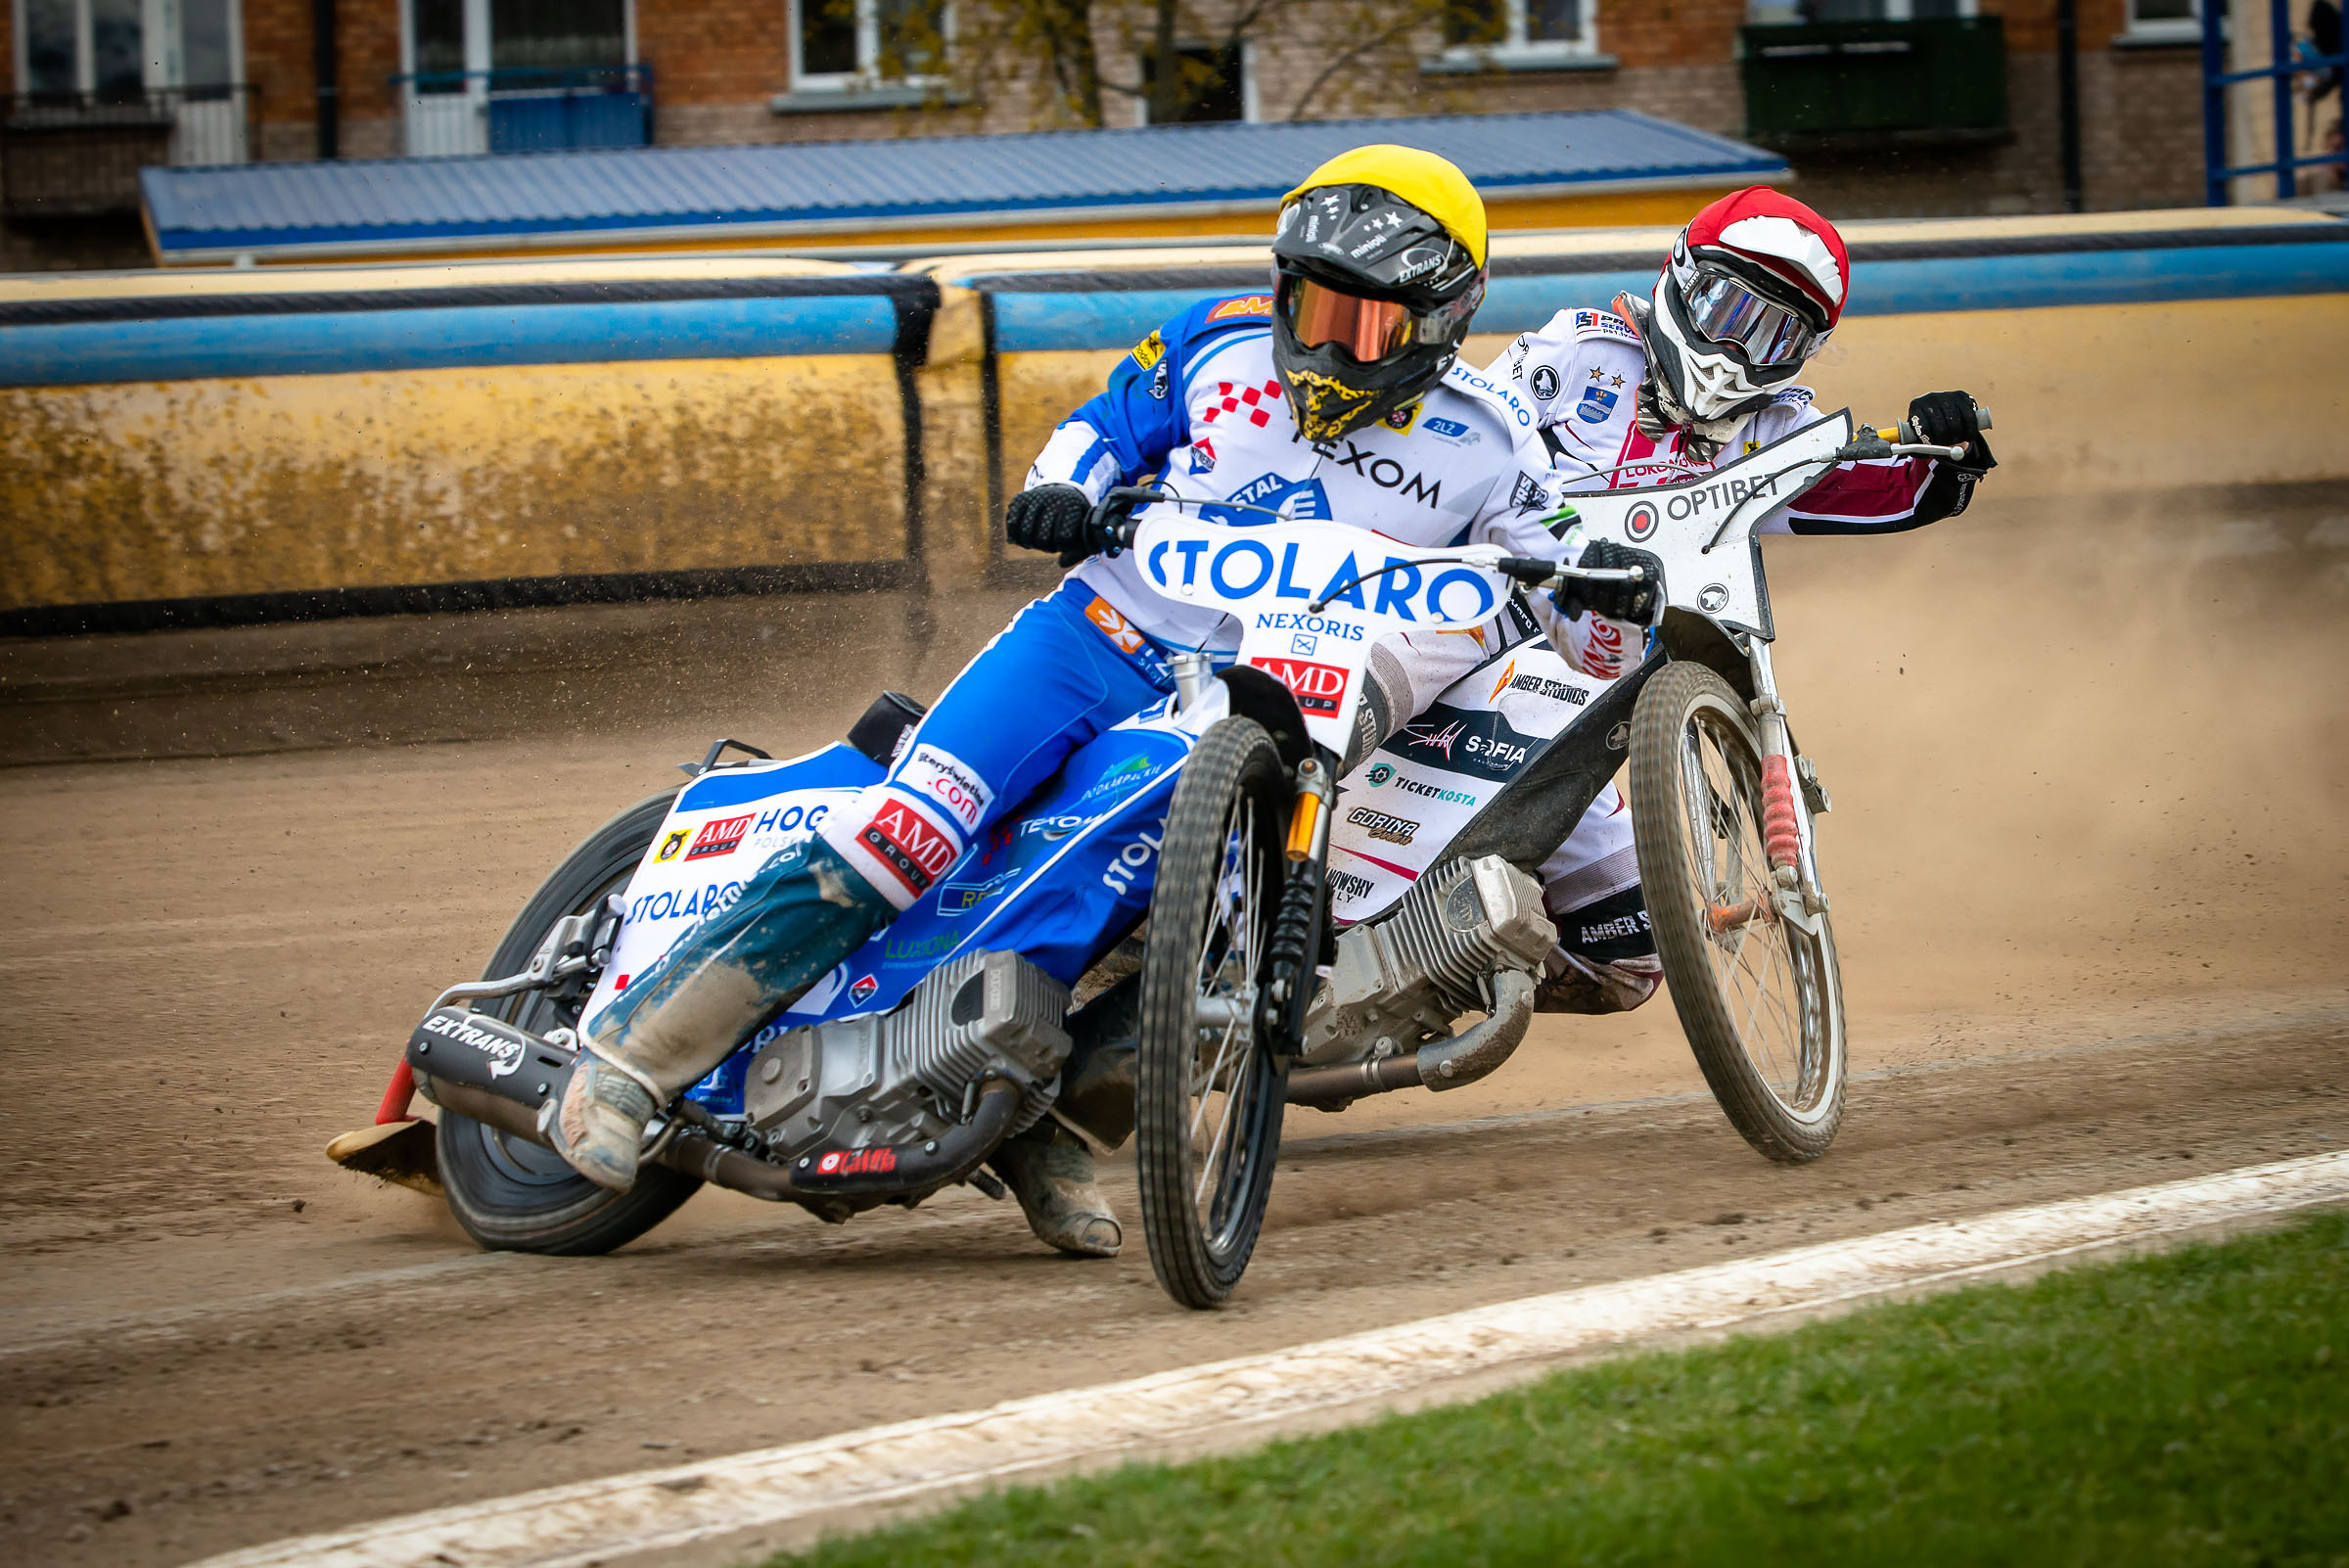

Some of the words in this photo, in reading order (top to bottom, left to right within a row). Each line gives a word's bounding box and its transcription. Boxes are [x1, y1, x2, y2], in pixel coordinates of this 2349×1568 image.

[1399, 254, 1443, 284] EXTRANS
[1451, 366, 1531, 427] STOLARO
[1667, 472, 1779, 521] OPTIBET
[1148, 539, 1495, 623] STOLARO
[1256, 613, 1365, 642] NEXORIS
[1508, 673, 1543, 691] AMBER
[1540, 679, 1590, 707] STUDIOS
[1394, 776, 1477, 807] TICKETKOSTA
[696, 816, 752, 845] AMD
[1348, 807, 1419, 838] GORINA
[690, 841, 738, 855] GROUP
[876, 808, 951, 876] AMD
[1581, 914, 1640, 945] AMBER
[422, 1014, 522, 1059] EXTRANS
